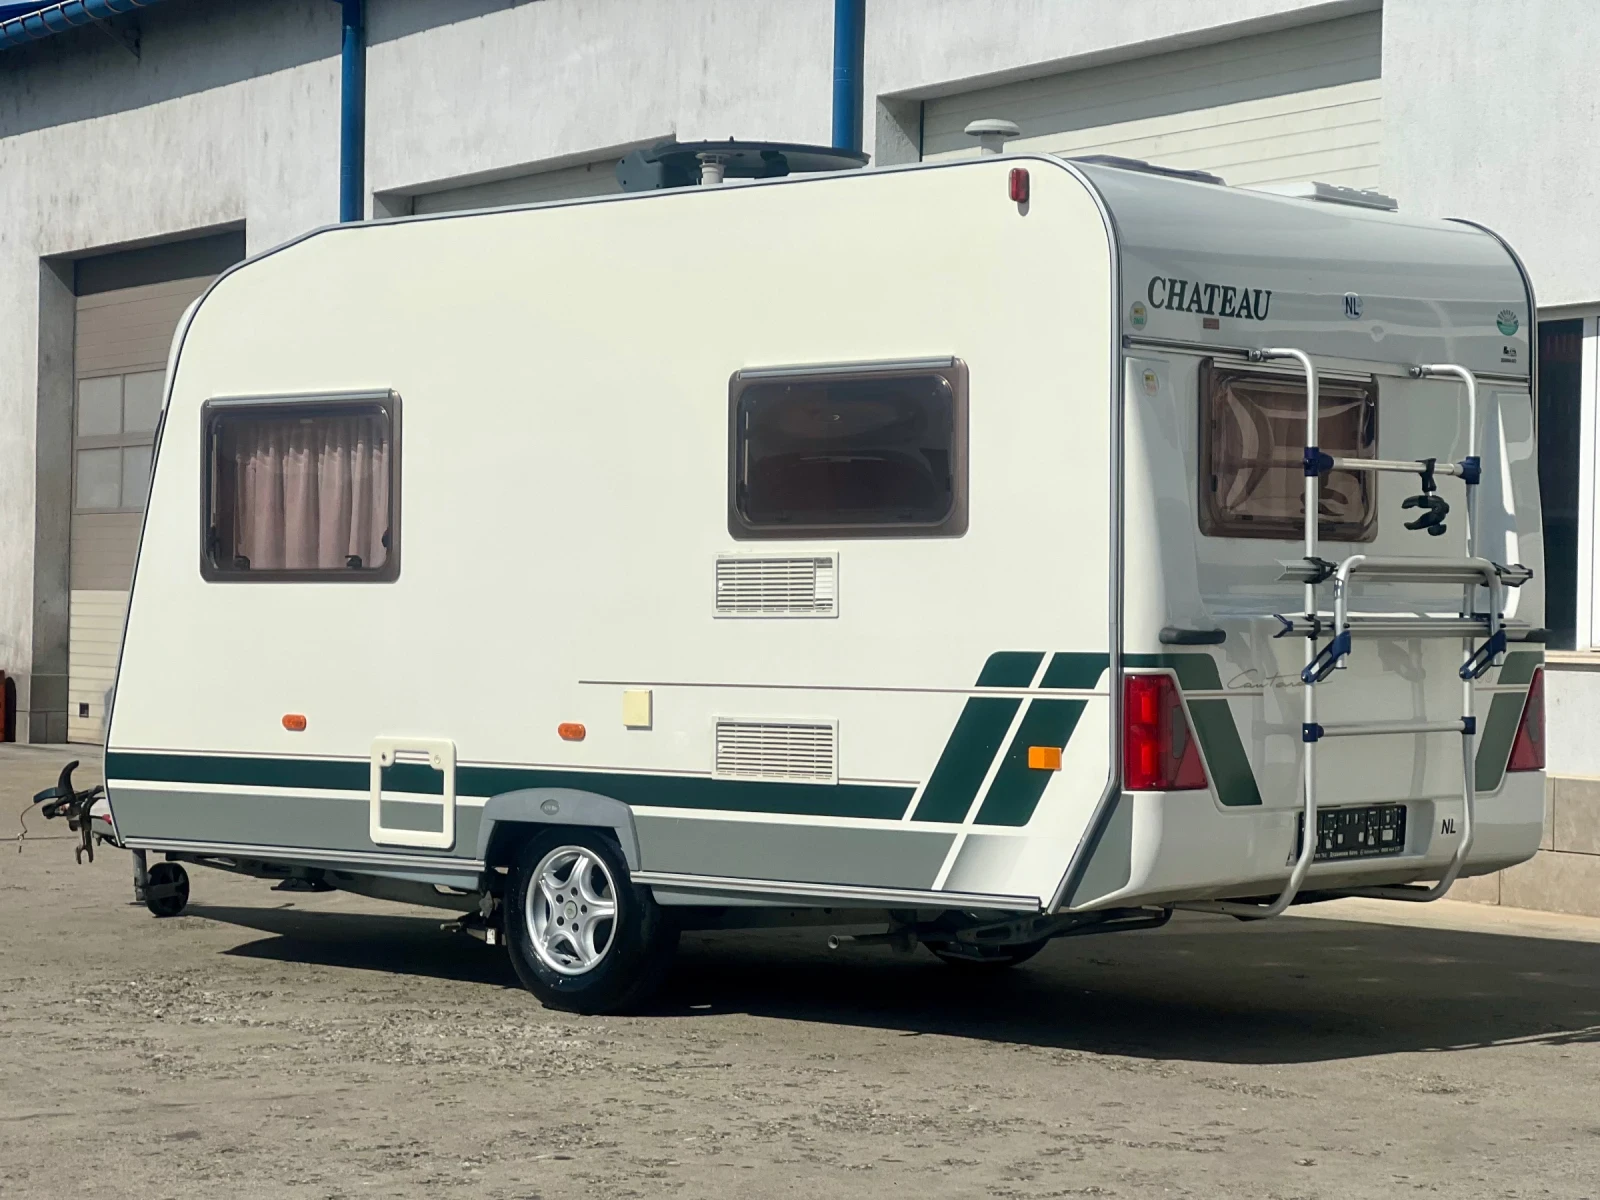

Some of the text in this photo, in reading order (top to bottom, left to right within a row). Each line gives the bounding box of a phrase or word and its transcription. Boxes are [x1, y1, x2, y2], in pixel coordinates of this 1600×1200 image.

[1148, 276, 1272, 320] CHATEAU
[1345, 296, 1360, 316] NL
[1441, 818, 1457, 834] NL
